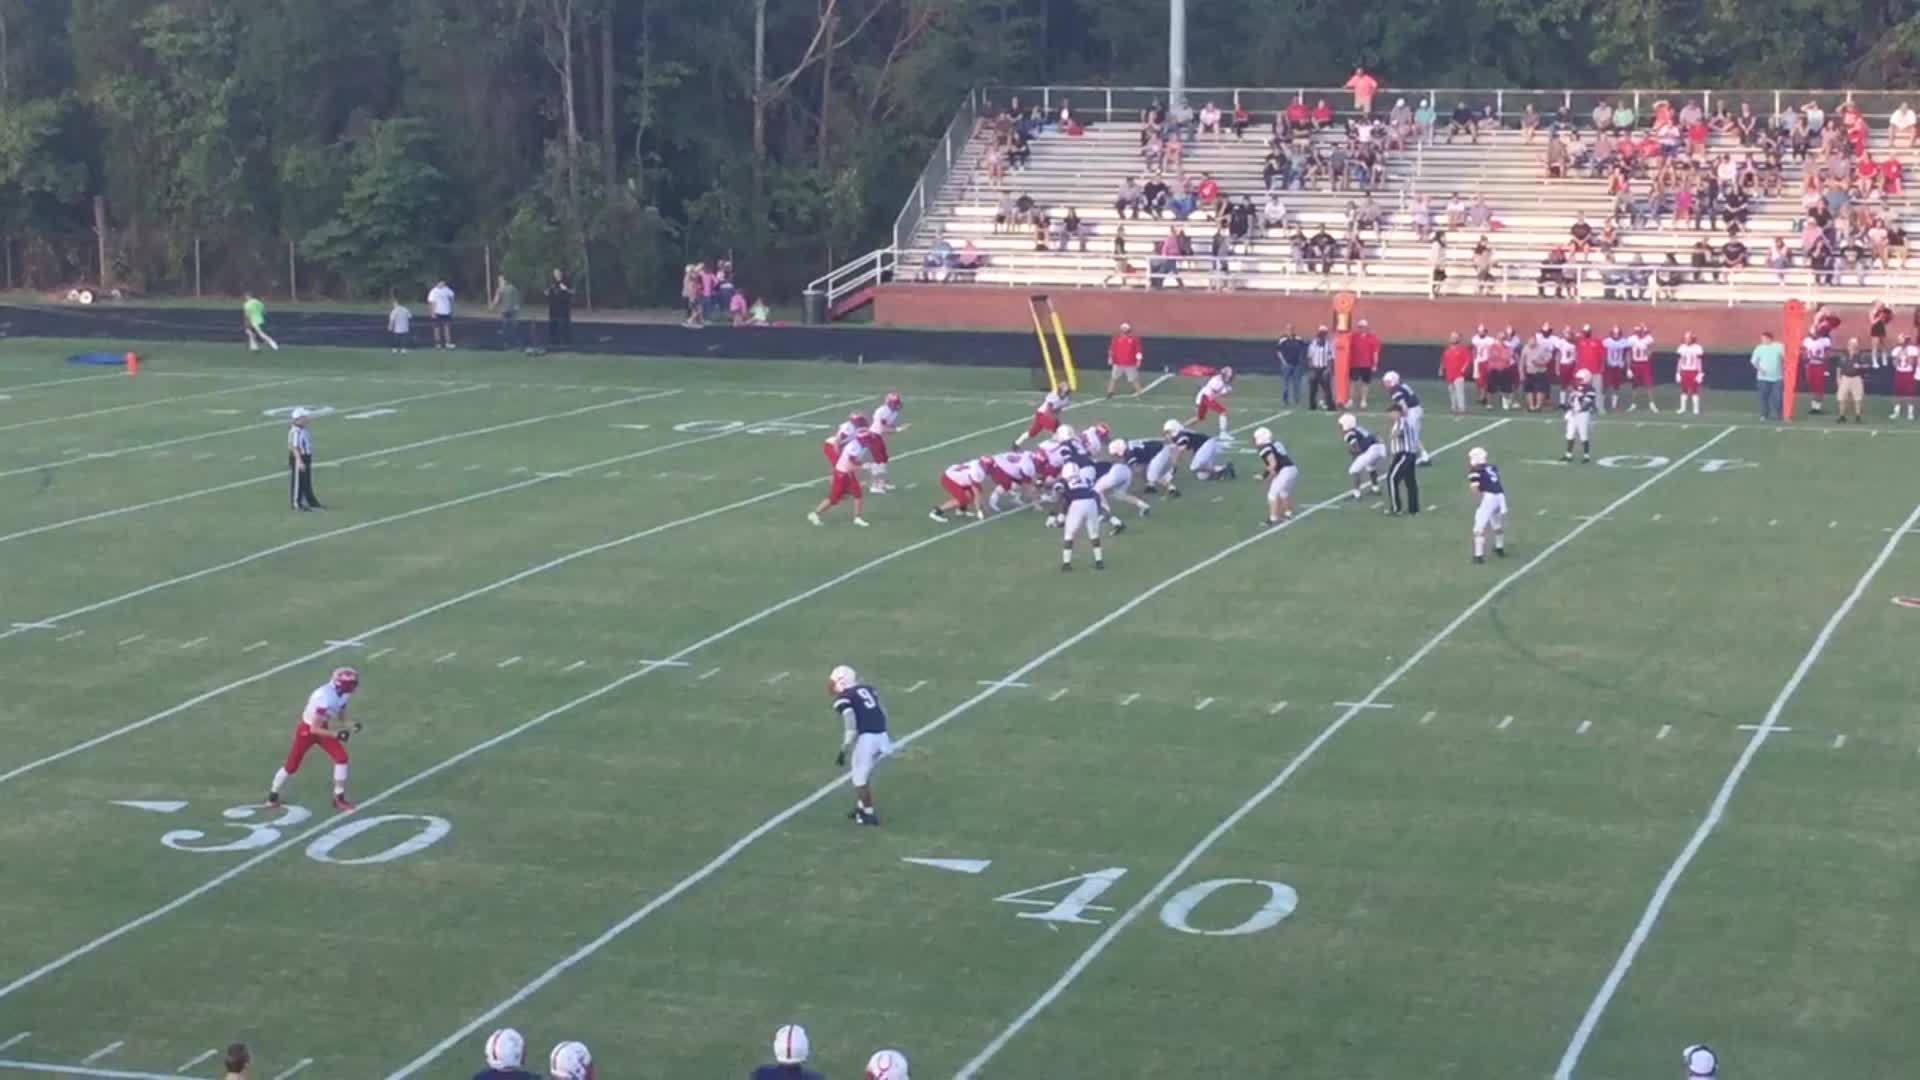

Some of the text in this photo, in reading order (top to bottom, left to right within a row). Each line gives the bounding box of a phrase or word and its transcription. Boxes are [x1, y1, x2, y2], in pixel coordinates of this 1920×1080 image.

[857, 687, 876, 709] 9
[161, 803, 452, 865] 30
[993, 867, 1299, 936] 40
